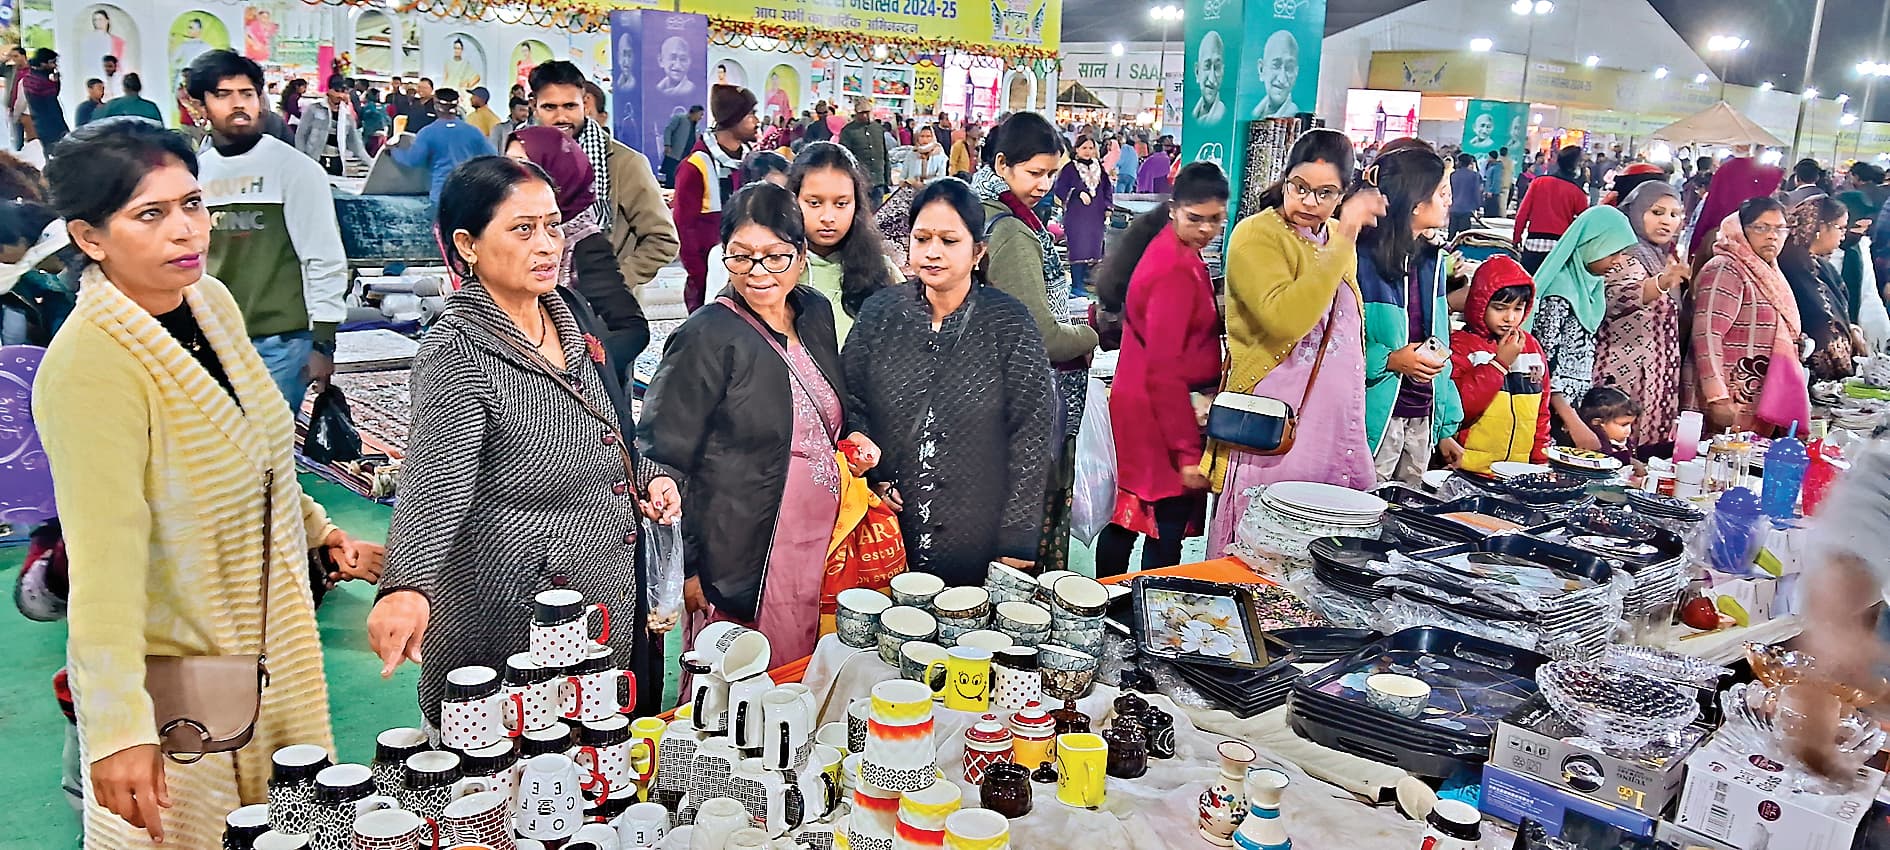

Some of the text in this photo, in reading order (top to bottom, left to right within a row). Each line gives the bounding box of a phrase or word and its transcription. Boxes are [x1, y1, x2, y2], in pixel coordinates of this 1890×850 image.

[902, 0, 957, 18] 2024-25
[1078, 62, 1108, 78] साल
[861, 538, 905, 562] estyl
